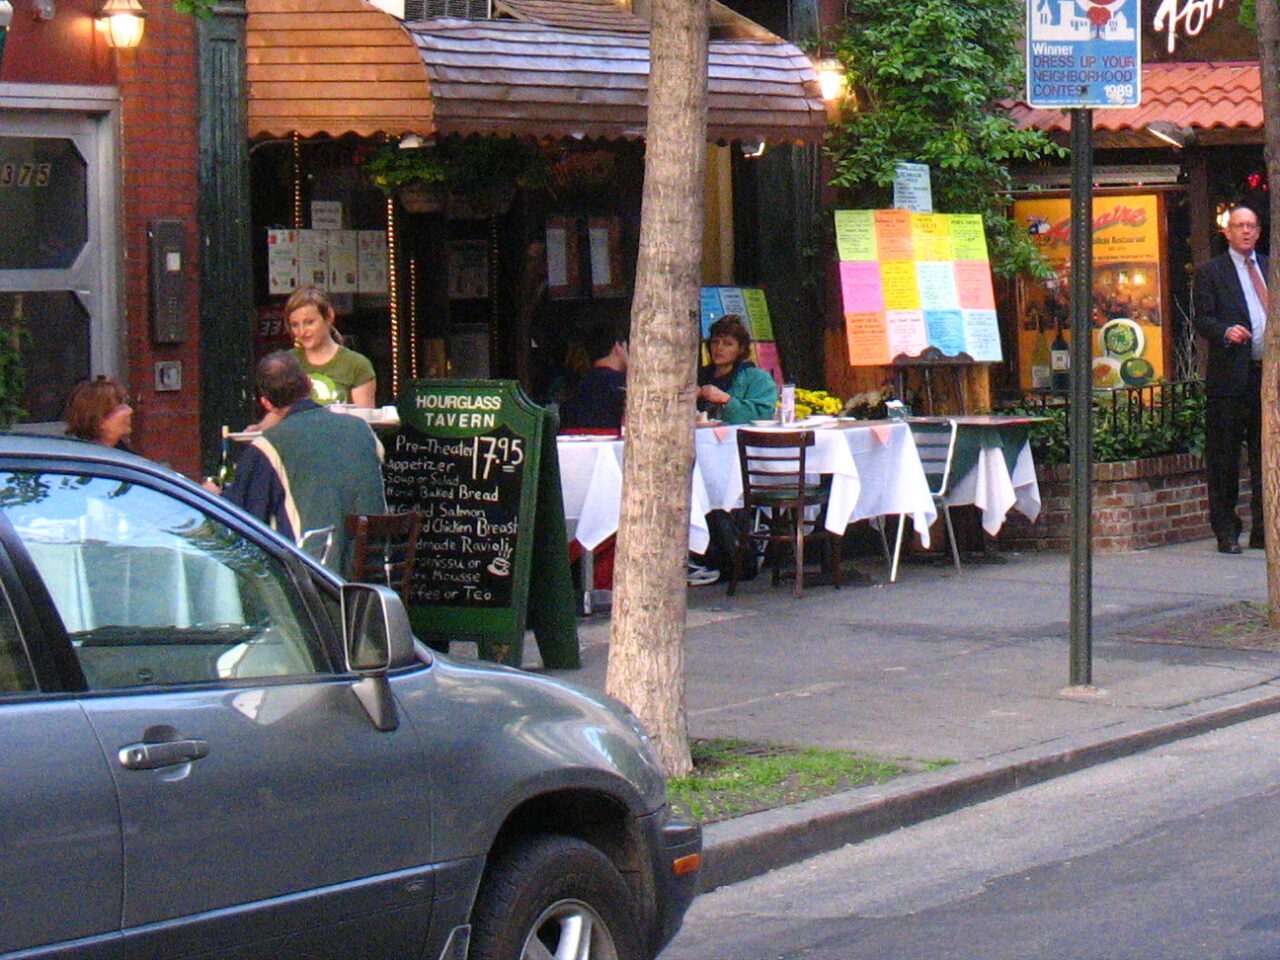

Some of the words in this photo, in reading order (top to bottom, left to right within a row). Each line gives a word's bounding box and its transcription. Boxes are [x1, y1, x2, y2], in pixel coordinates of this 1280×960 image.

[1032, 42, 1074, 56] Winner
[1033, 55, 1074, 68] DRESS
[1080, 55, 1096, 68] UP
[1102, 55, 1136, 68] YOUR
[1033, 70, 1133, 82] NEIGHBORHOOD
[1033, 84, 1090, 97] CONTEST
[1104, 84, 1133, 97] 1989
[416, 395, 502, 410] HOURGLASS
[425, 413, 496, 428] TAVERN
[458, 483, 500, 502] Bread
[439, 502, 486, 518] Salmon
[432, 517, 473, 533] Chicken
[476, 516, 518, 537] Breast
[460, 535, 511, 553] Ravioli
[467, 560, 482, 569] or
[463, 585, 492, 601] Tea
